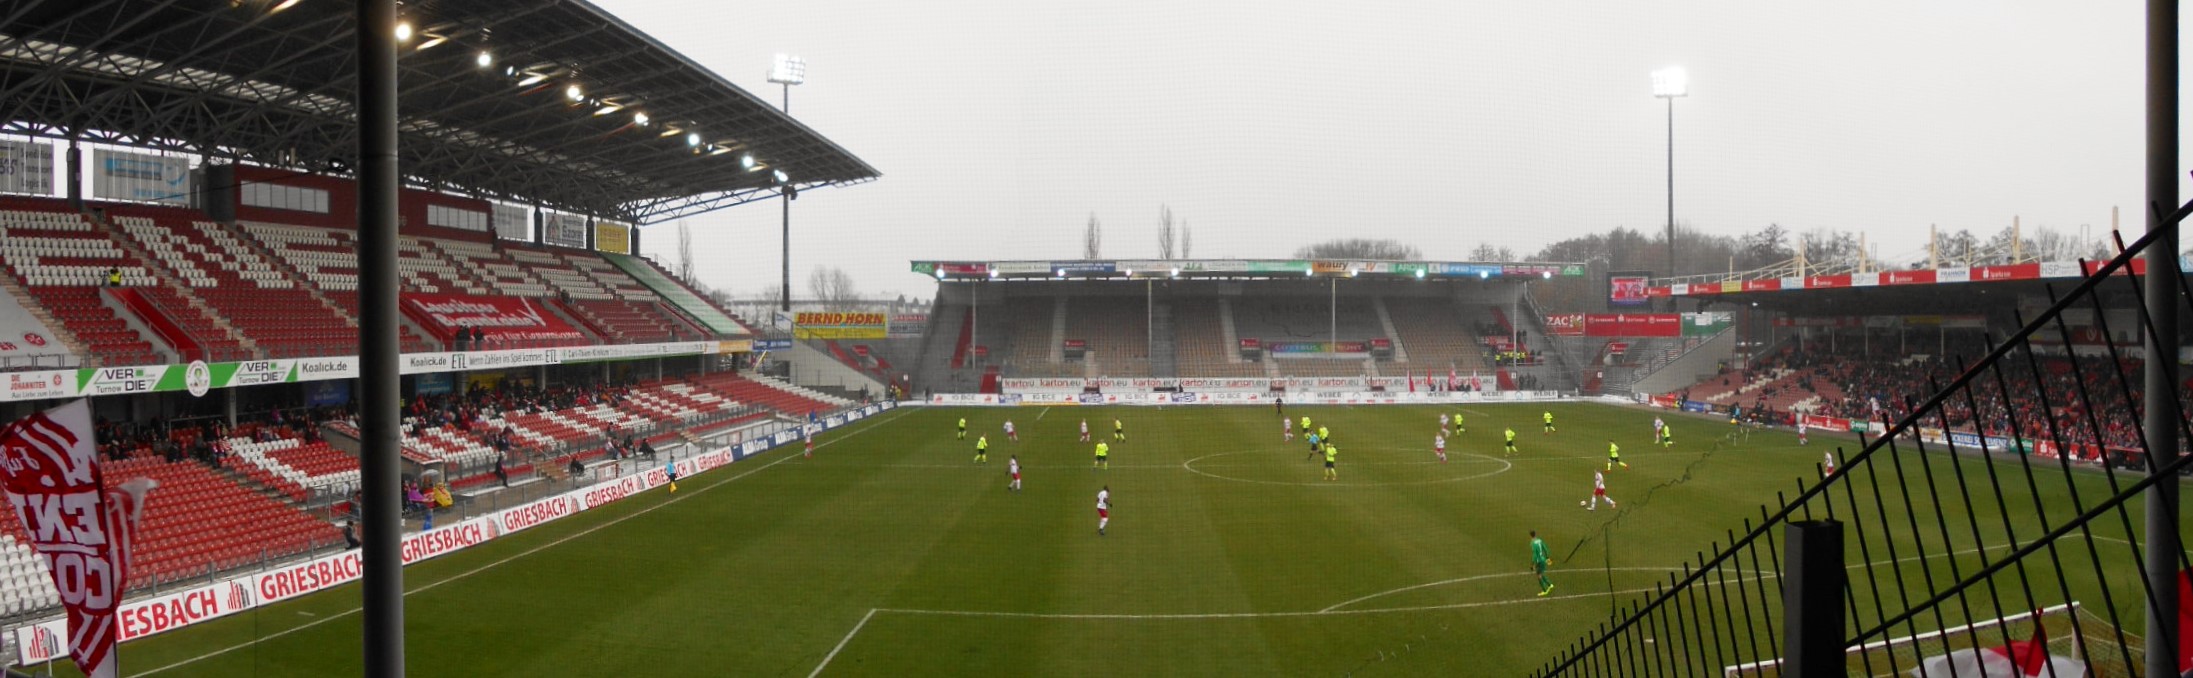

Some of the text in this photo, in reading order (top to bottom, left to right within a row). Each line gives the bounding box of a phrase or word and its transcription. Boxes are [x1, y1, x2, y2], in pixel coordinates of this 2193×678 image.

[797, 312, 843, 325] BERND
[845, 312, 885, 325] HORN
[1547, 316, 1569, 326] ZAC
[246, 361, 269, 372] VER
[302, 360, 348, 373] Koalick.de
[105, 368, 134, 380] VER
[261, 372, 279, 382] DIE
[125, 380, 146, 391] DIE
[1040, 379, 1081, 387] karton.eu
[585, 477, 634, 508] GRIESBACH
[504, 497, 568, 531] GRIESBACH
[402, 522, 482, 563] GRIESBACH
